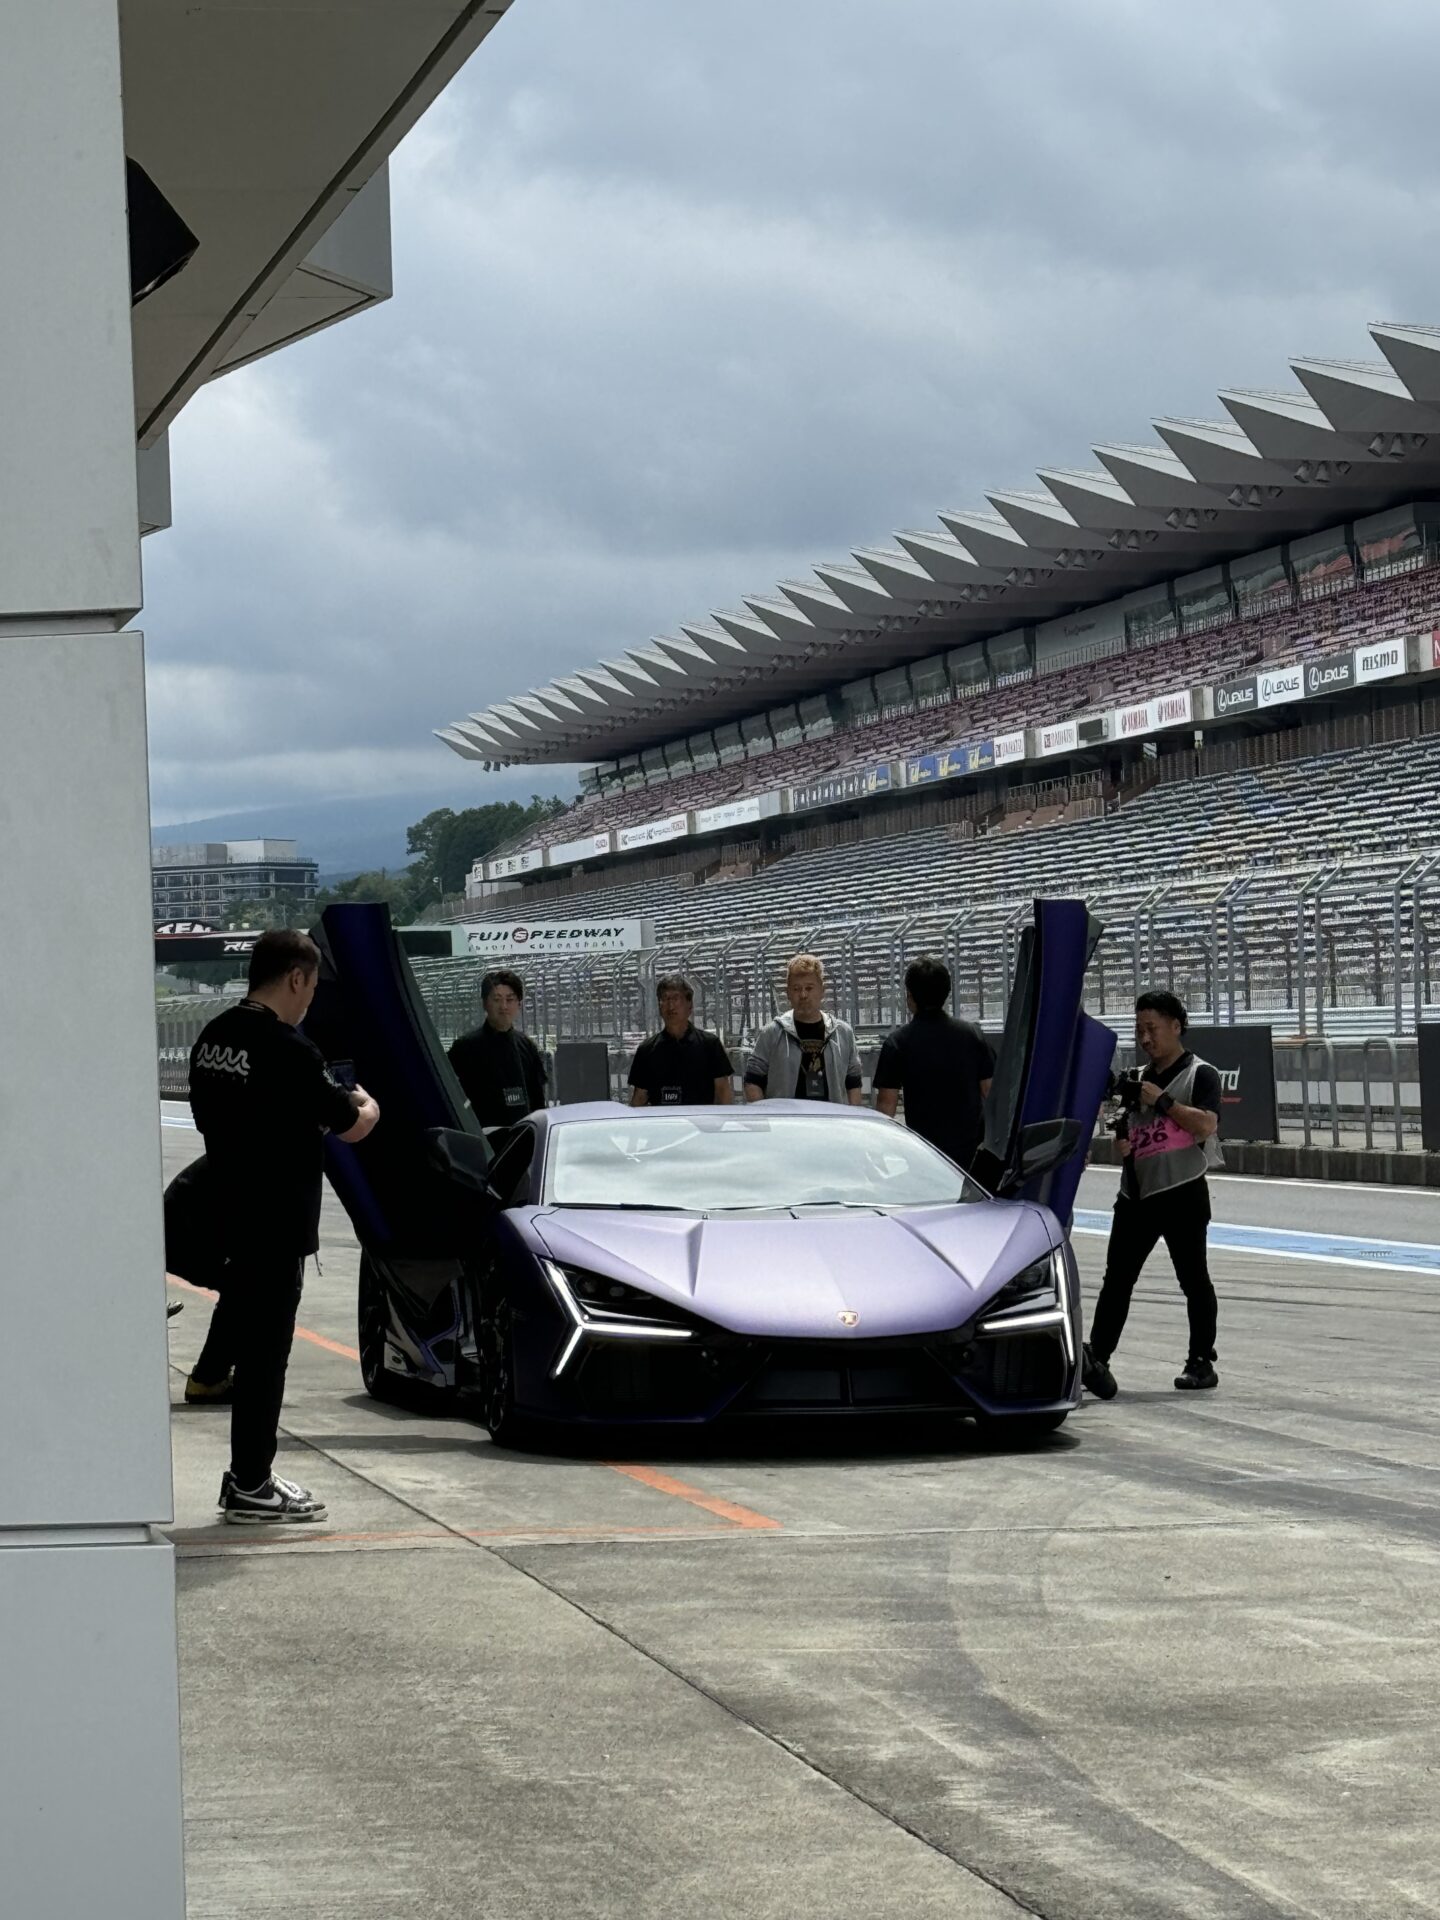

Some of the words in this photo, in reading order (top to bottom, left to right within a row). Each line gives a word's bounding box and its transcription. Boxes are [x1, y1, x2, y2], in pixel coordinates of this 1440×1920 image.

[1319, 665, 1349, 683] LEXUS
[1271, 676, 1300, 694] LEXUS
[1226, 688, 1254, 706] LEXUS
[467, 931, 509, 942] FUJI
